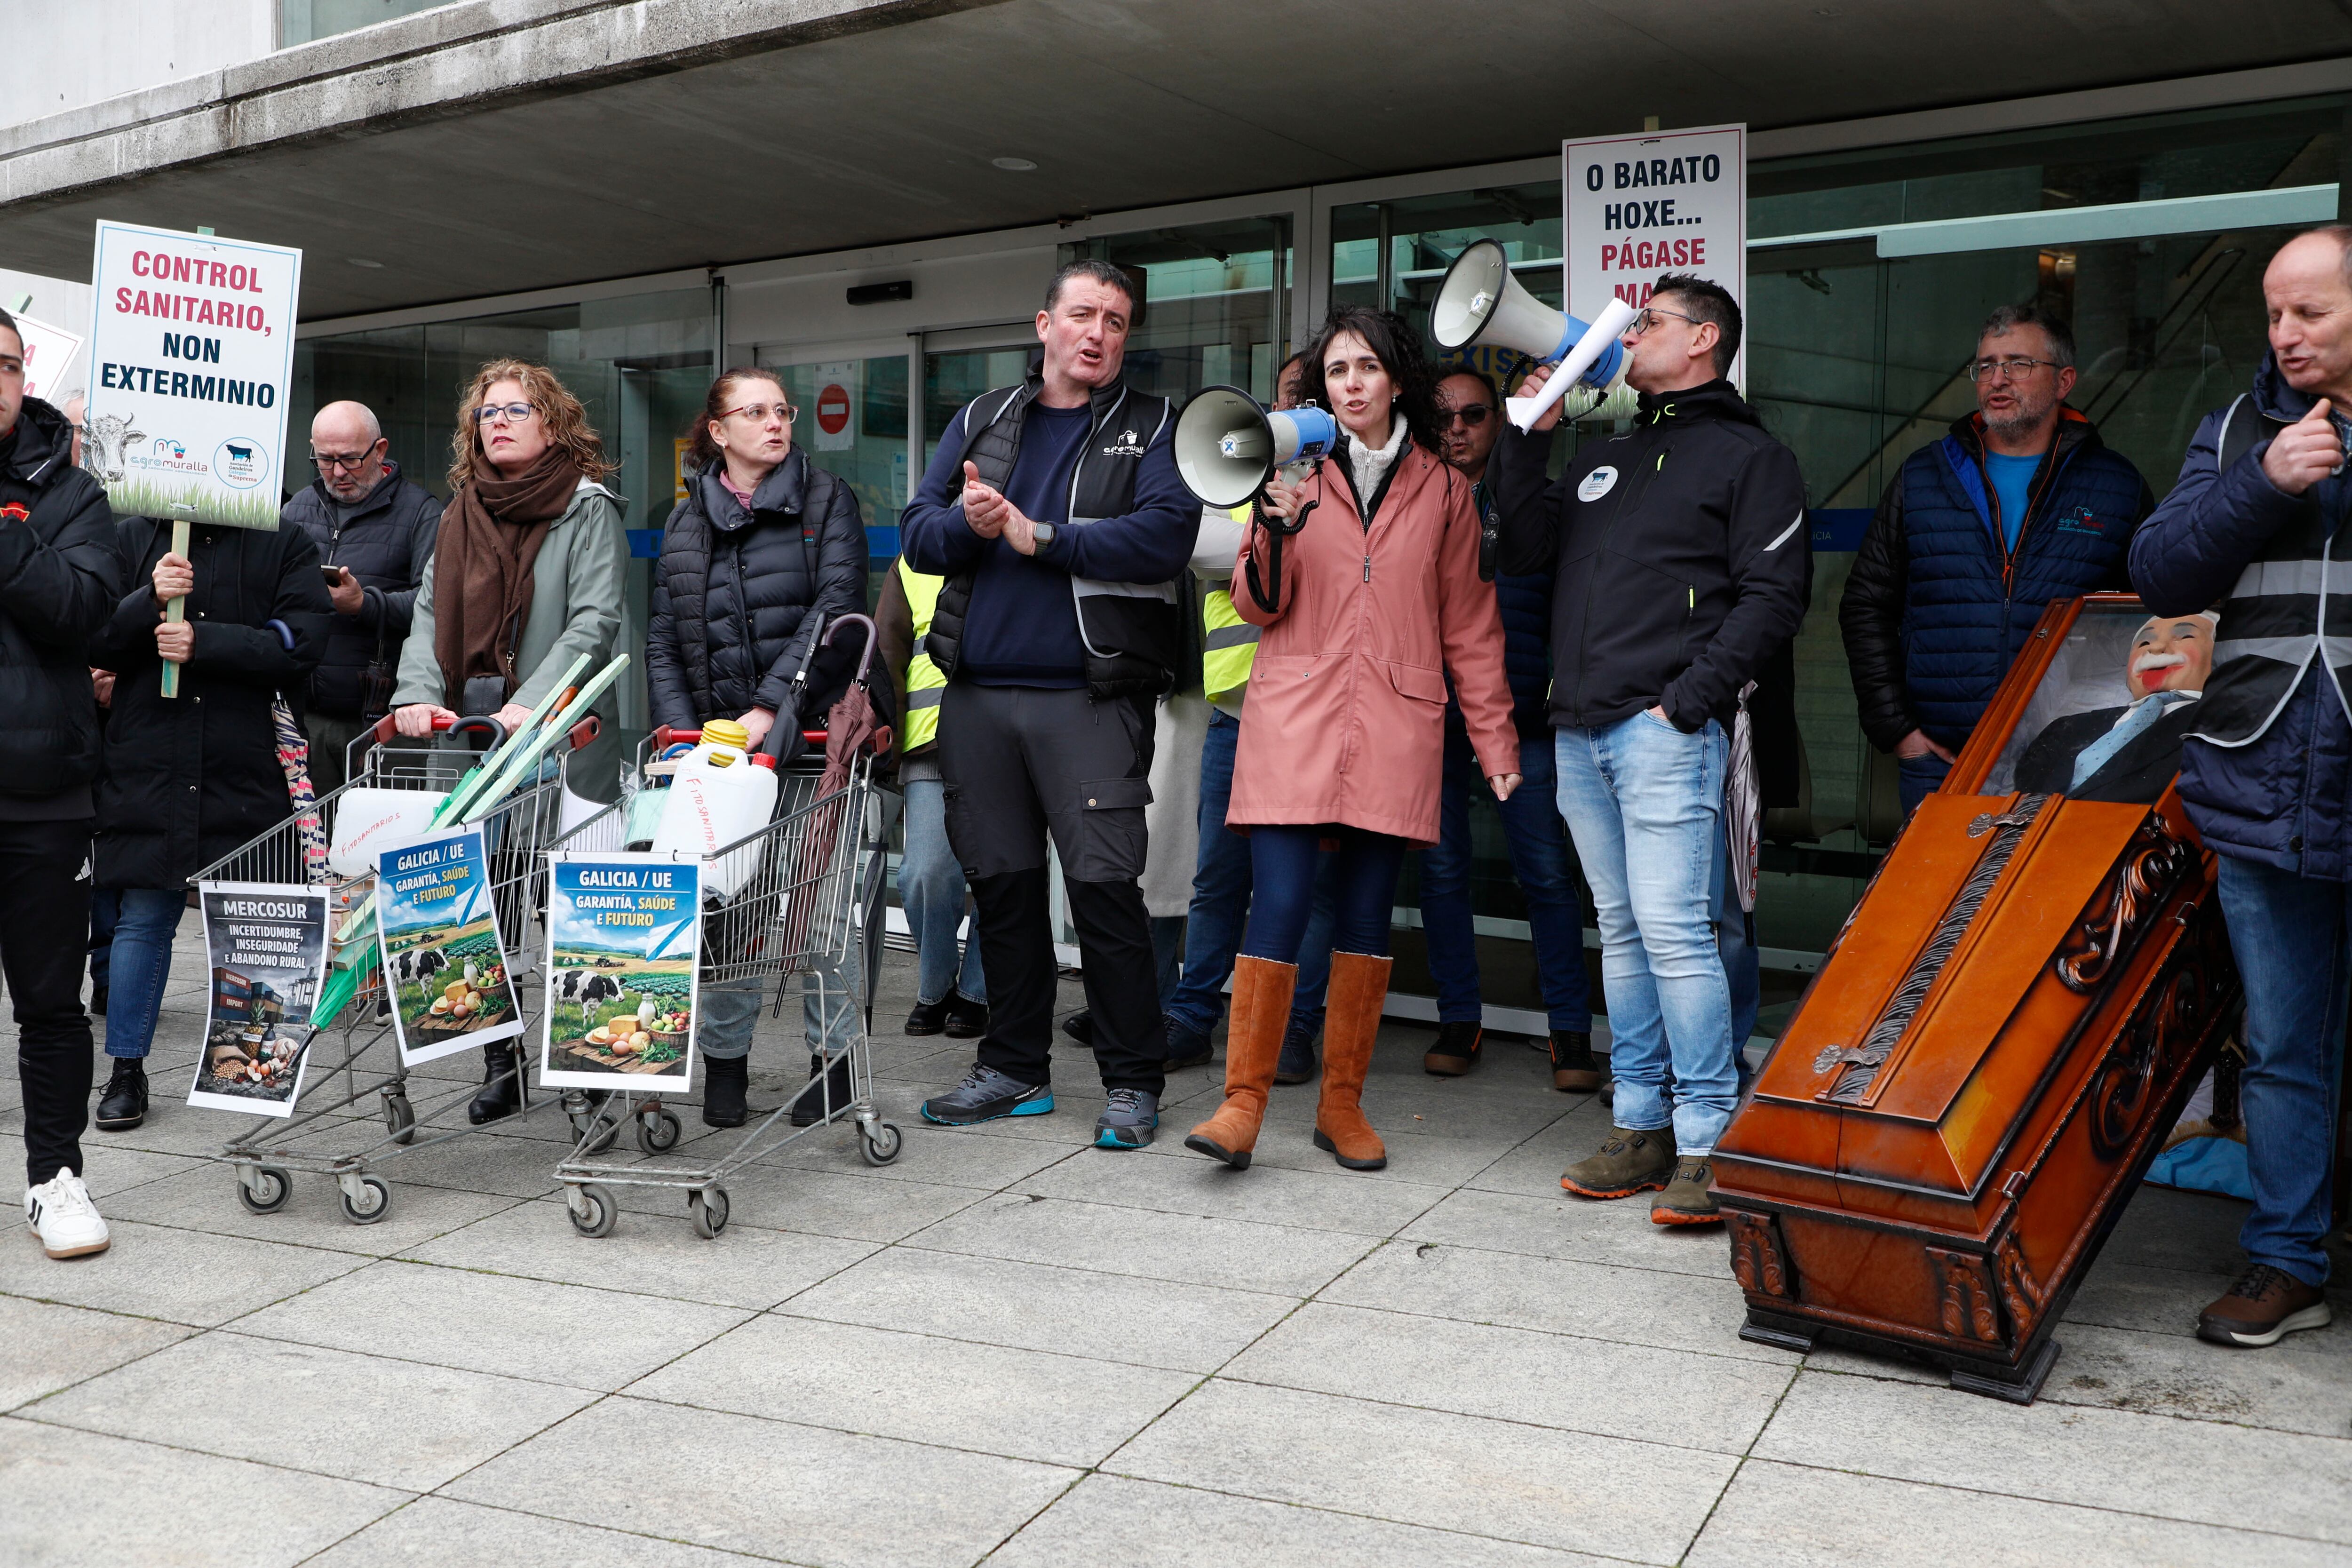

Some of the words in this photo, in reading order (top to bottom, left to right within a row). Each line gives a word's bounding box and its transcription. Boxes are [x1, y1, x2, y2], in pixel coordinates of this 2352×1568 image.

[1586, 164, 1604, 191] O
[1614, 153, 1720, 189] BARATO
[1605, 199, 1702, 231] HOXE...
[1601, 237, 1706, 271] PÁGASE
[132, 250, 262, 293] CONTROL
[1614, 282, 1654, 309] MA
[115, 287, 272, 337] SANITARIO,
[162, 332, 221, 364] NON
[101, 362, 275, 409] EXTERMINIO
[130, 455, 208, 472] agromuralla
[341, 812, 401, 857] FITOSANITARIOS
[686, 777, 718, 870] FITOSANITARS
[397, 849, 440, 871] GALICIA
[450, 843, 464, 860] UE
[396, 872, 442, 893] GARANTÍA,
[442, 865, 469, 883] SAÚDE
[579, 871, 638, 888] GALICIA
[652, 872, 672, 888] UE
[413, 894, 419, 905] E
[420, 884, 457, 903] FUTURO
[576, 894, 636, 912] GARANTÍA,
[638, 892, 676, 911] SAÚDE
[223, 900, 308, 919] MERCOSUR
[596, 914, 603, 926] E
[605, 913, 654, 927] FUTURO
[229, 924, 304, 941] INCERTIDUMBRE,
[236, 939, 299, 954] INSEGURIDADE
[224, 955, 230, 963] E
[230, 952, 278, 967] ABANDONO
[279, 955, 306, 970] RURAL
[225, 972, 247, 987] MERCOSUR
[226, 998, 244, 1008] IMPORT
